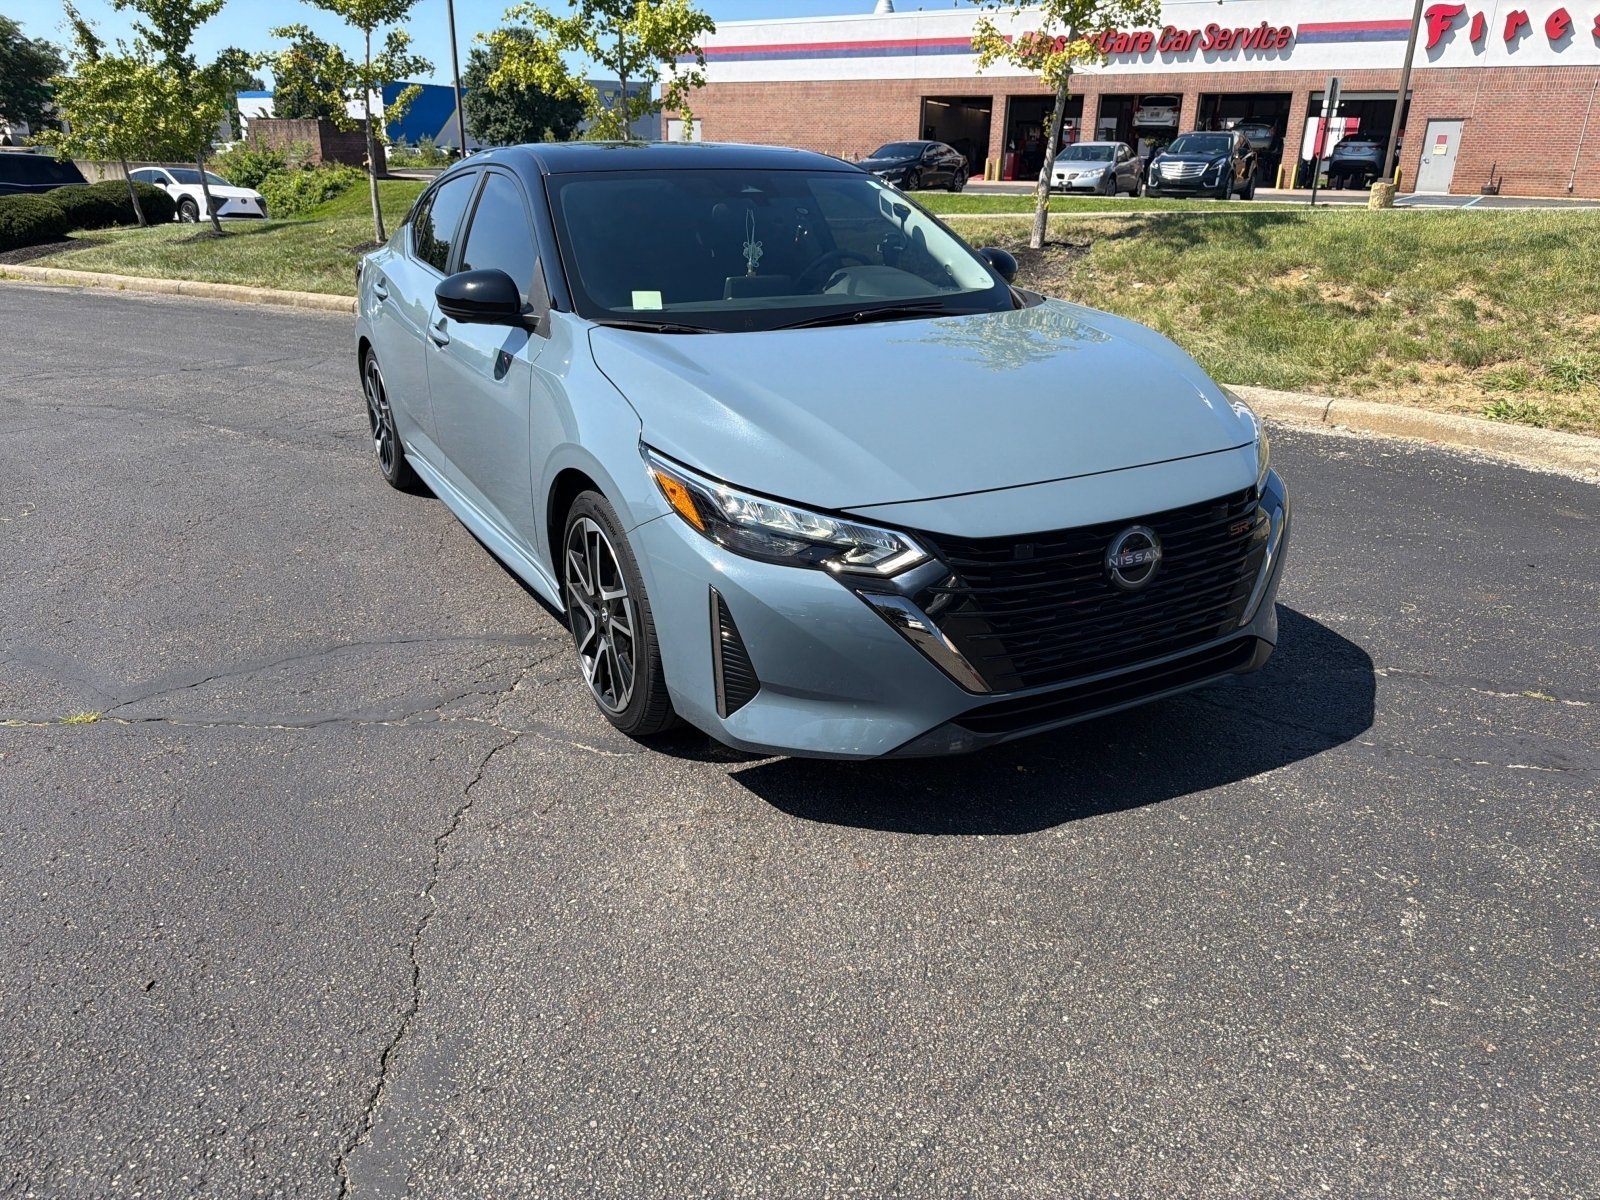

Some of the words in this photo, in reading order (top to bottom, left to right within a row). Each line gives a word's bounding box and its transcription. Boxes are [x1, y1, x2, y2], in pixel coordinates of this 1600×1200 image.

[1157, 25, 1200, 53] Car
[1200, 21, 1292, 51] Service
[1231, 520, 1250, 536] SR
[1108, 548, 1161, 568] NISSAN
